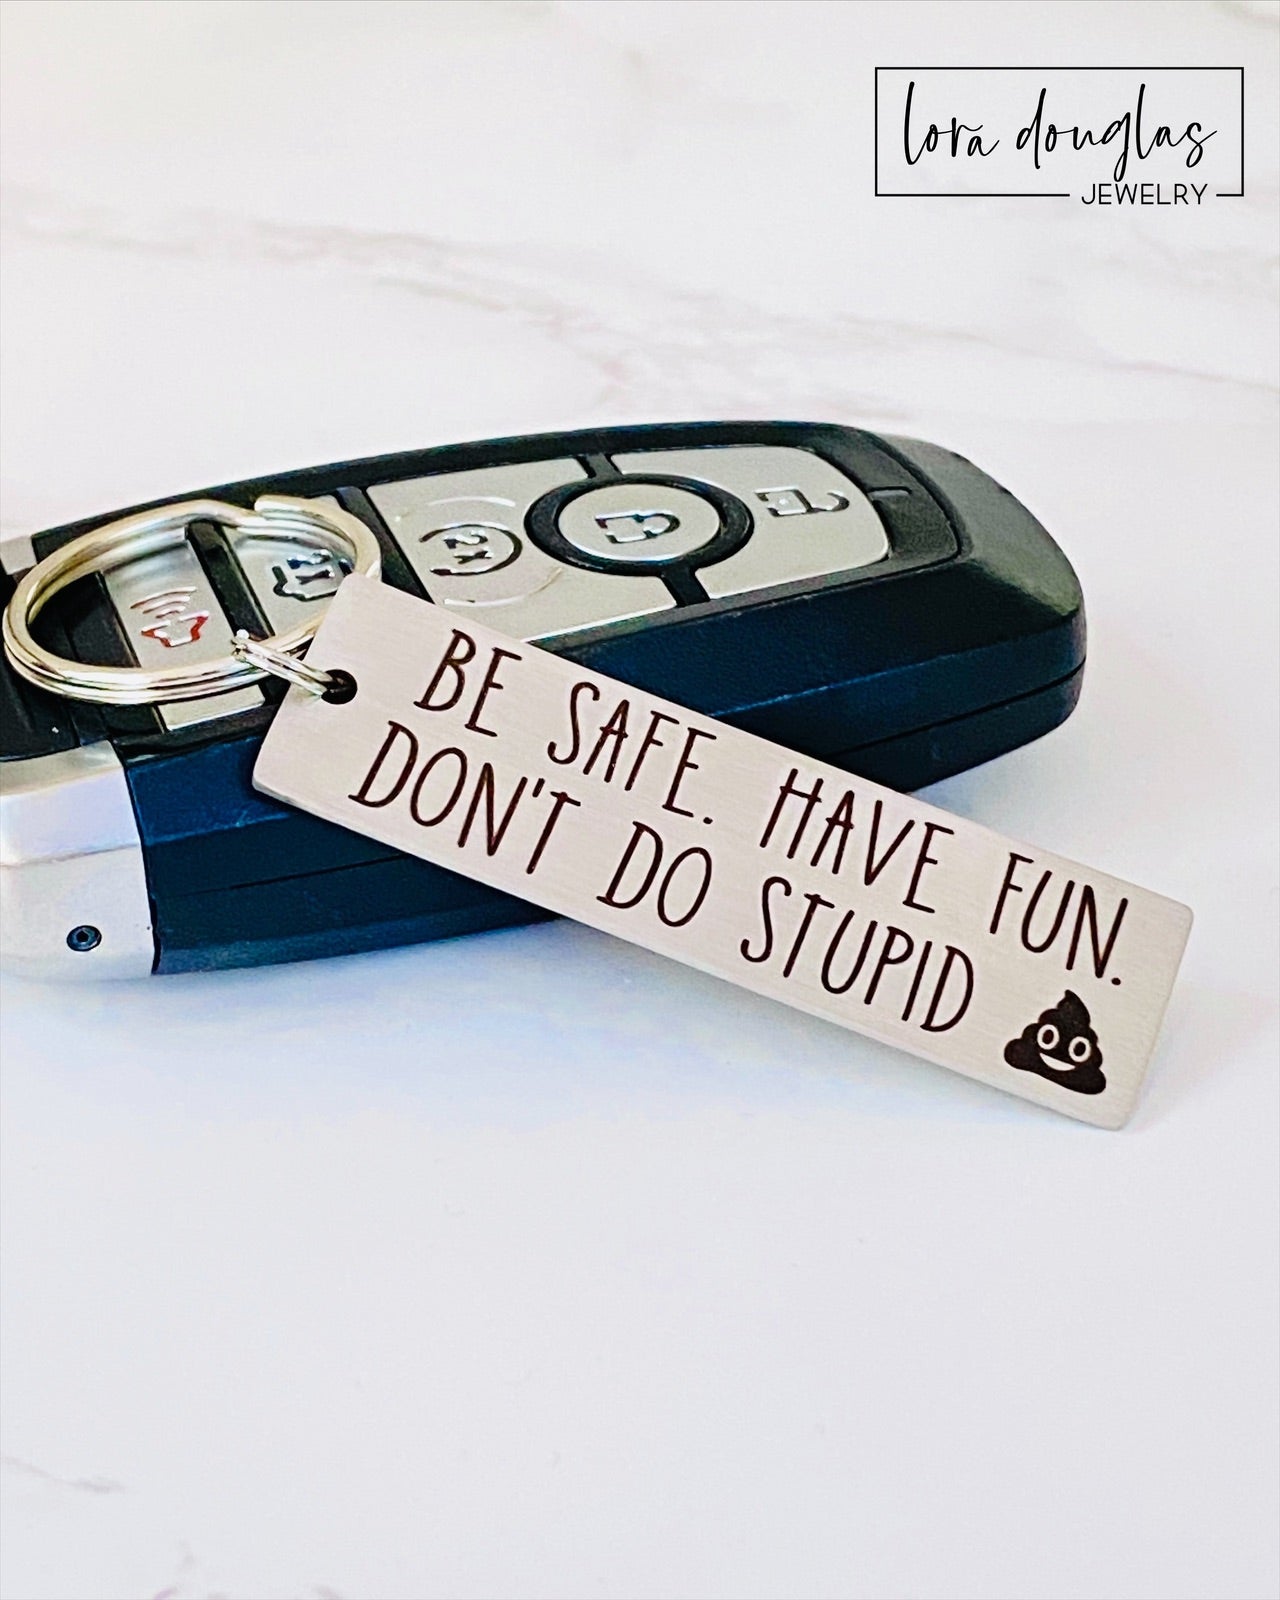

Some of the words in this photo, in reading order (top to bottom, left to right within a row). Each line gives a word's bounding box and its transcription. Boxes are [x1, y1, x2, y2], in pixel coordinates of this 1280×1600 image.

[348, 721, 581, 875] DON'T
[597, 821, 712, 928] DO
[741, 877, 974, 1033] STUPID
[414, 629, 522, 738] BE
[548, 682, 717, 825] SAFE.
[760, 769, 955, 914] HAVE
[990, 853, 1129, 986] FUN.
